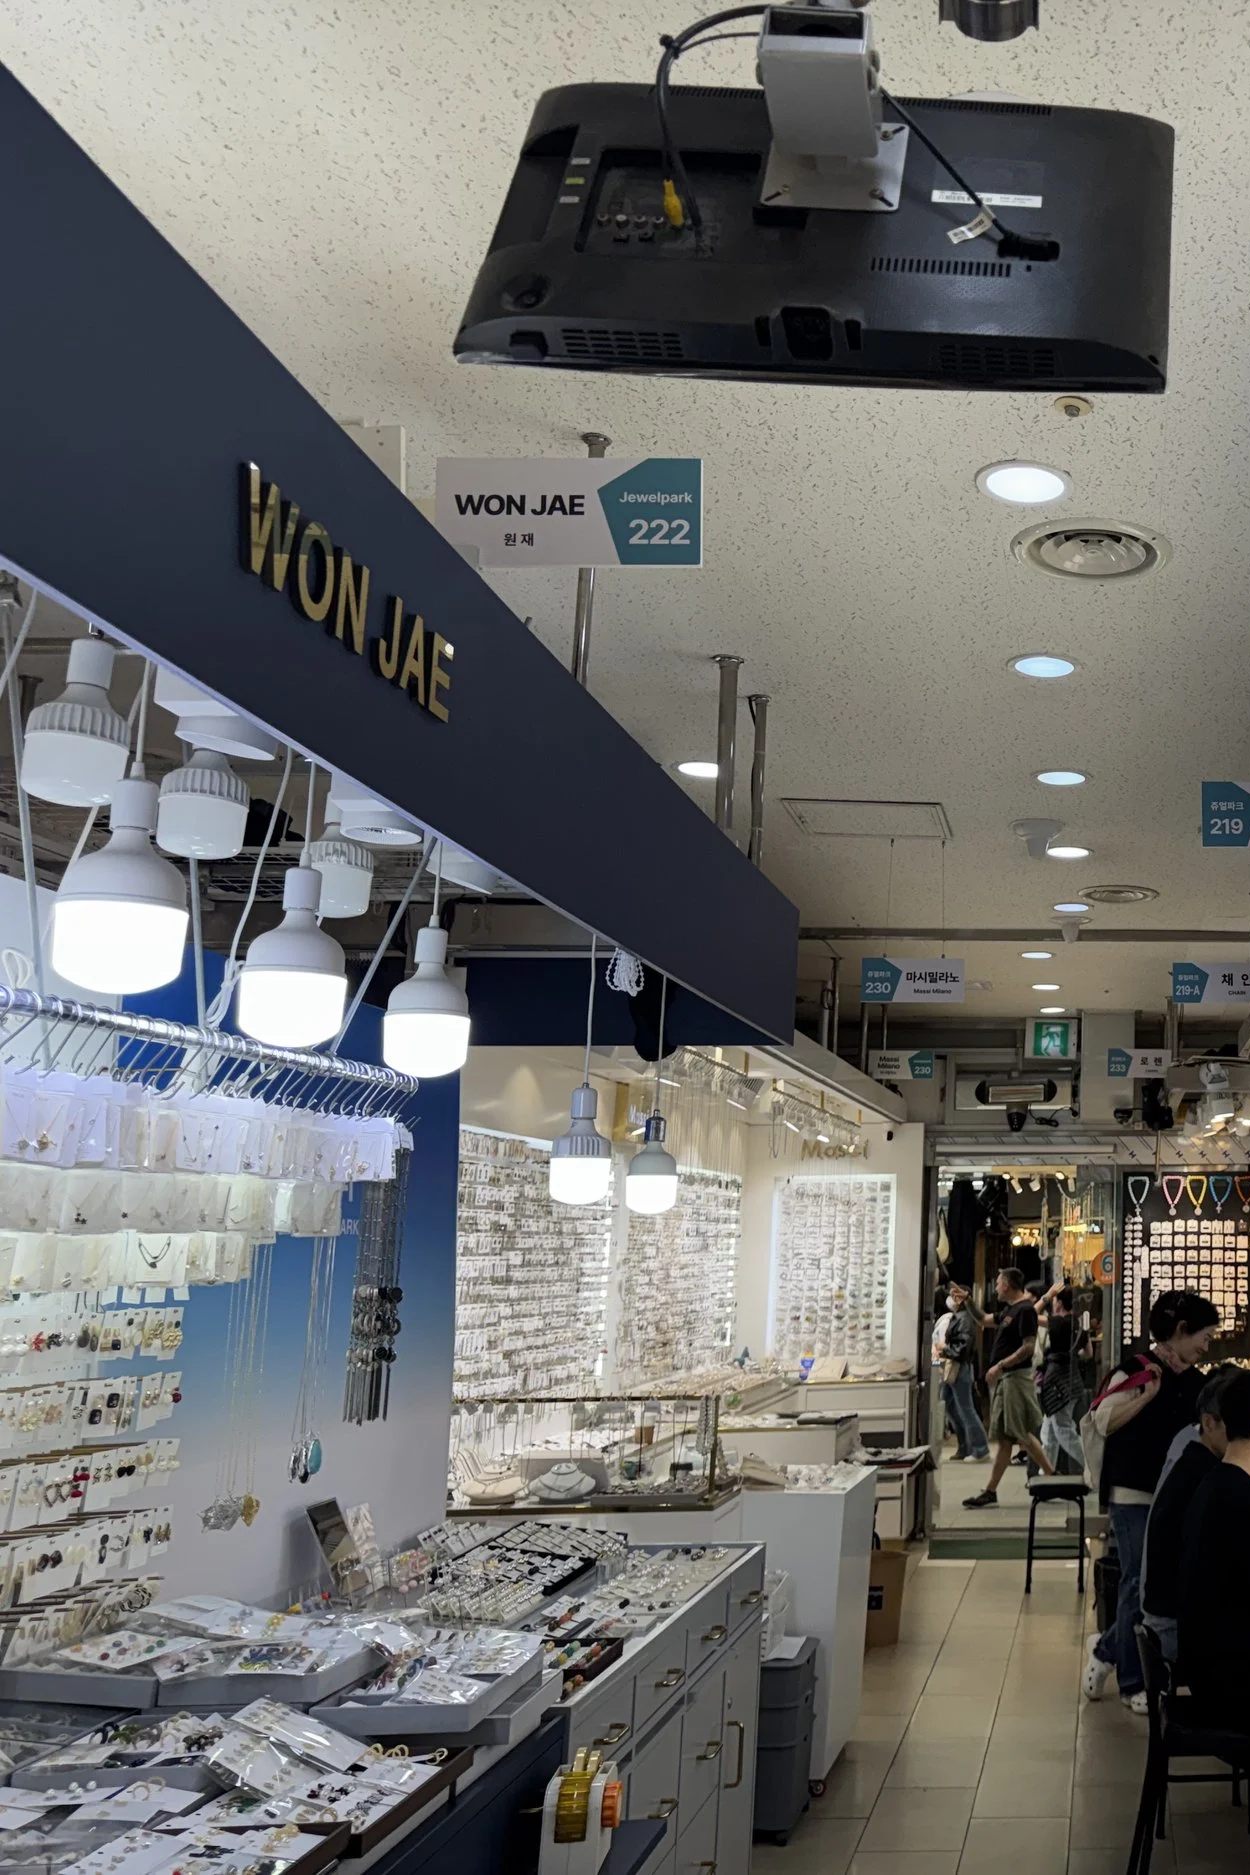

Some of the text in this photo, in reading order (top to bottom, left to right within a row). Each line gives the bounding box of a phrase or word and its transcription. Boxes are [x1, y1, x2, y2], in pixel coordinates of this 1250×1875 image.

[454, 494, 585, 516] WON JAE
[619, 491, 693, 506] Jewelpark
[628, 518, 691, 545] 222
[240, 460, 455, 724] WON JAE
[1210, 801, 1245, 811] 쥬얼파크
[1209, 818, 1244, 835] 219
[906, 971, 960, 984] 마시밀라노
[865, 982, 891, 994] 230
[1175, 985, 1200, 996] 219-A
[914, 1066, 931, 1074] 230
[1110, 1064, 1126, 1072] 233
